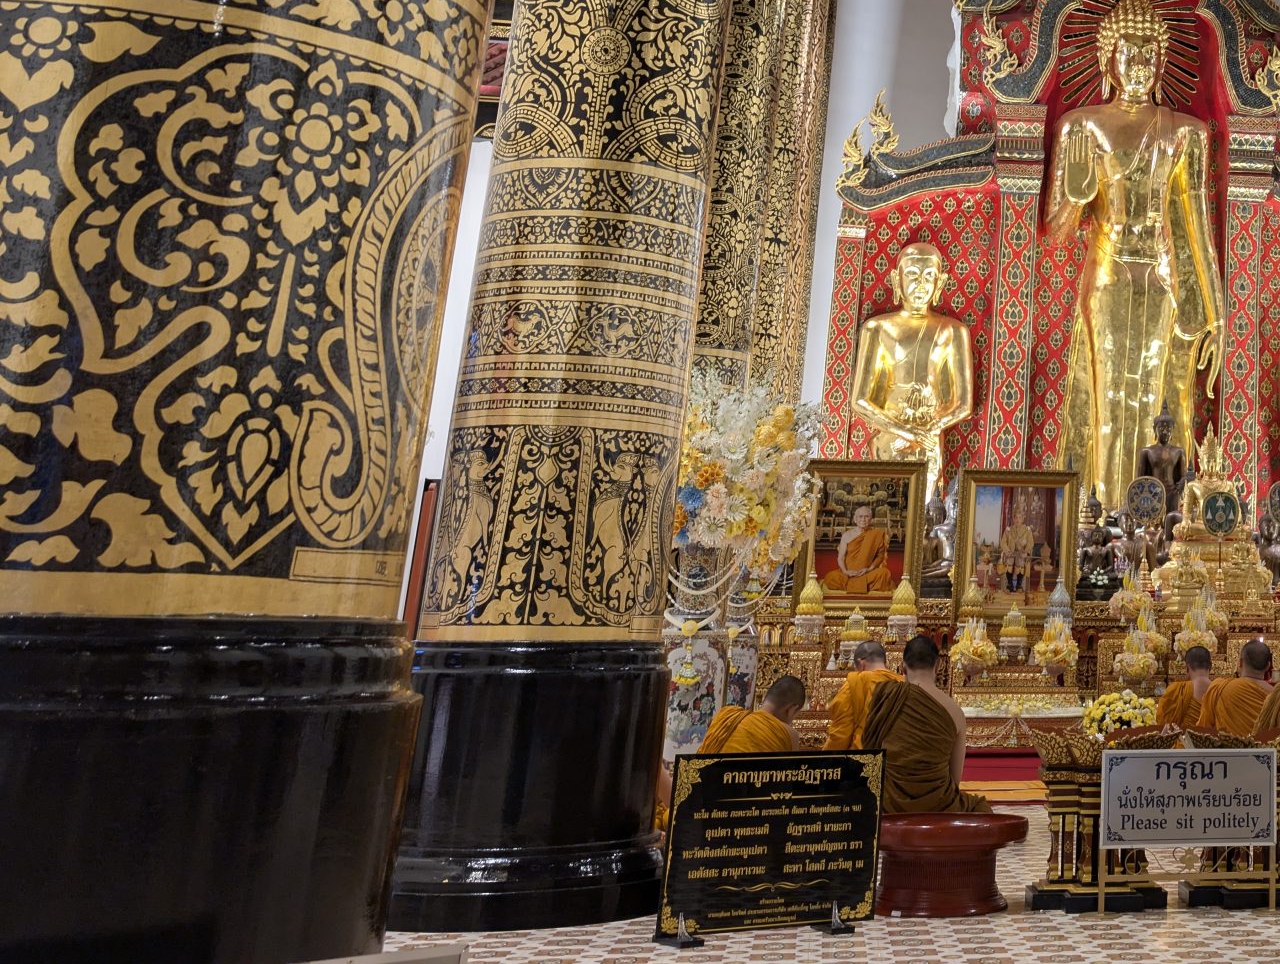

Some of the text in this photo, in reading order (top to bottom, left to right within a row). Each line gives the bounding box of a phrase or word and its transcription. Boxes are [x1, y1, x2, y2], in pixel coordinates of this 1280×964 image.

[723, 764, 841, 787] คาถาบูชาพระอัฏฐารส
[1154, 759, 1228, 787] กรุณา
[1117, 785, 1262, 814] นั่งให้สุภาพเรียบร้อย
[1120, 813, 1260, 833] Please sit politely
